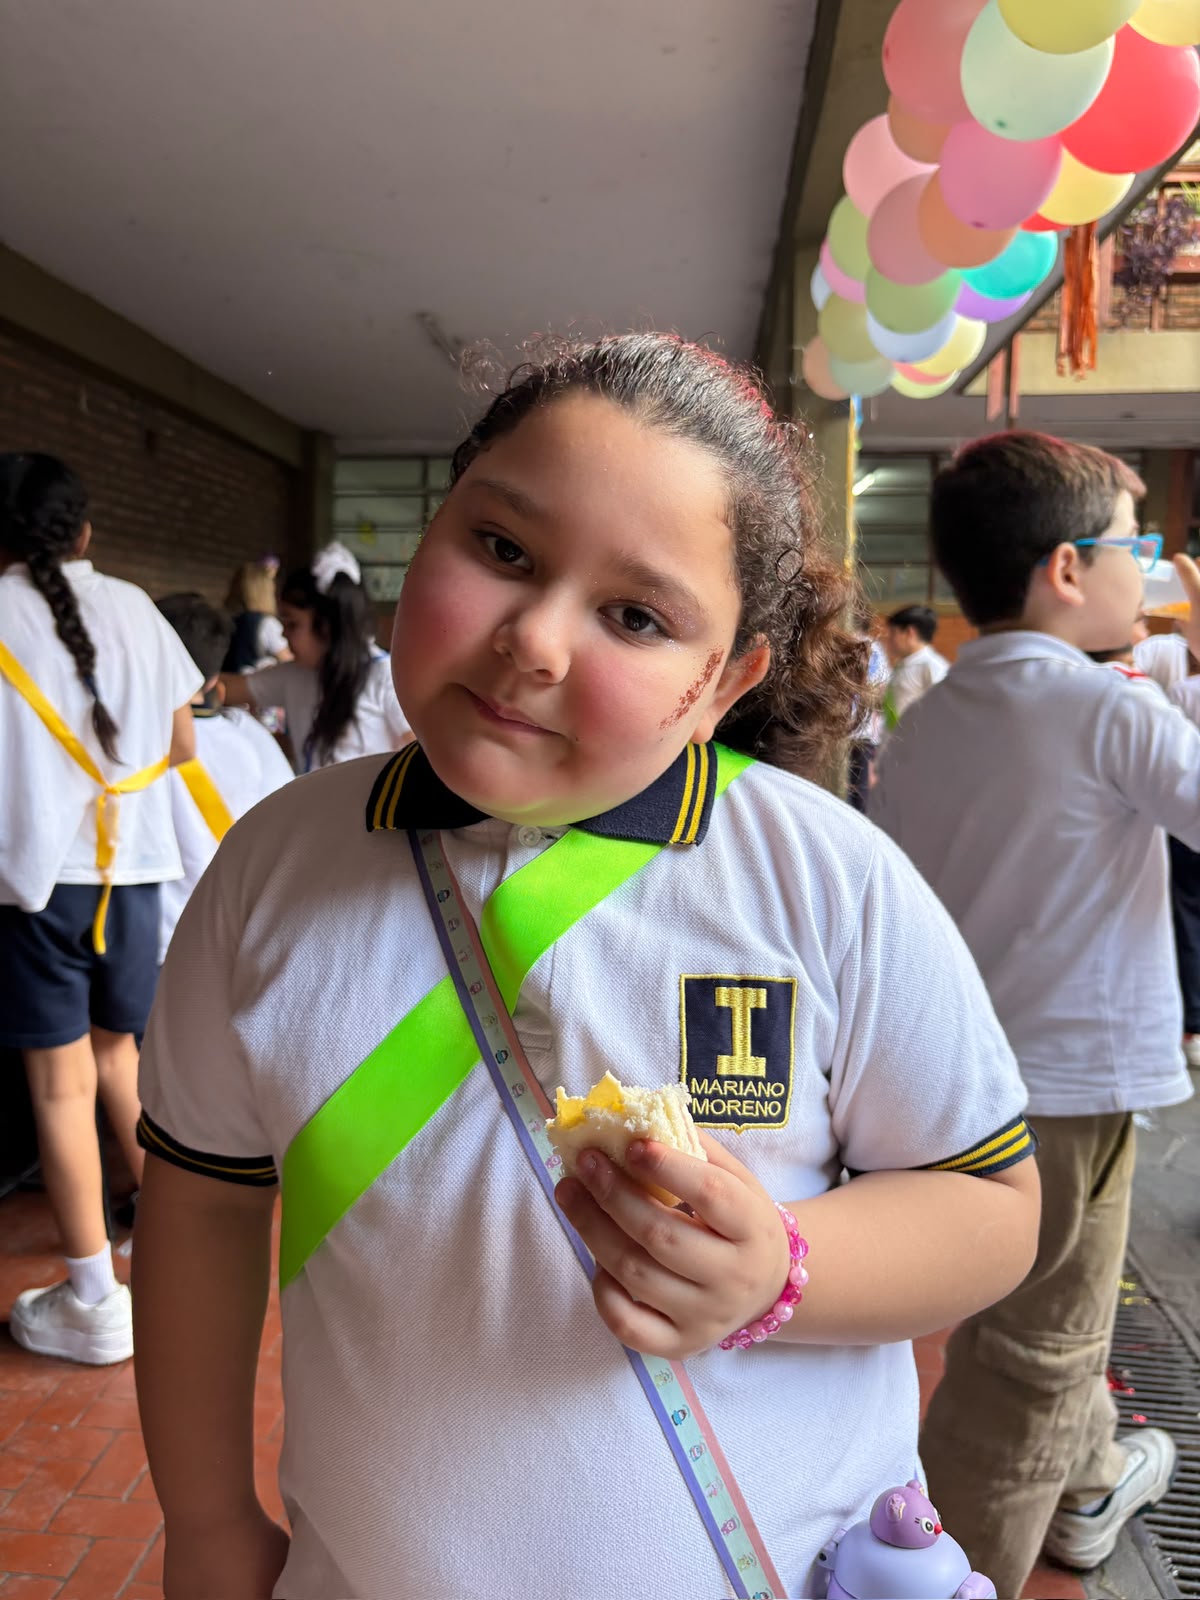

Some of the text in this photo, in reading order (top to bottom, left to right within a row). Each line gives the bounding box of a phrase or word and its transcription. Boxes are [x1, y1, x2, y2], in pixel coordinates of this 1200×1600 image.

[715, 986, 767, 1078] I
[691, 1077, 785, 1098] MARIANO
[691, 1098, 782, 1117] MORENO
